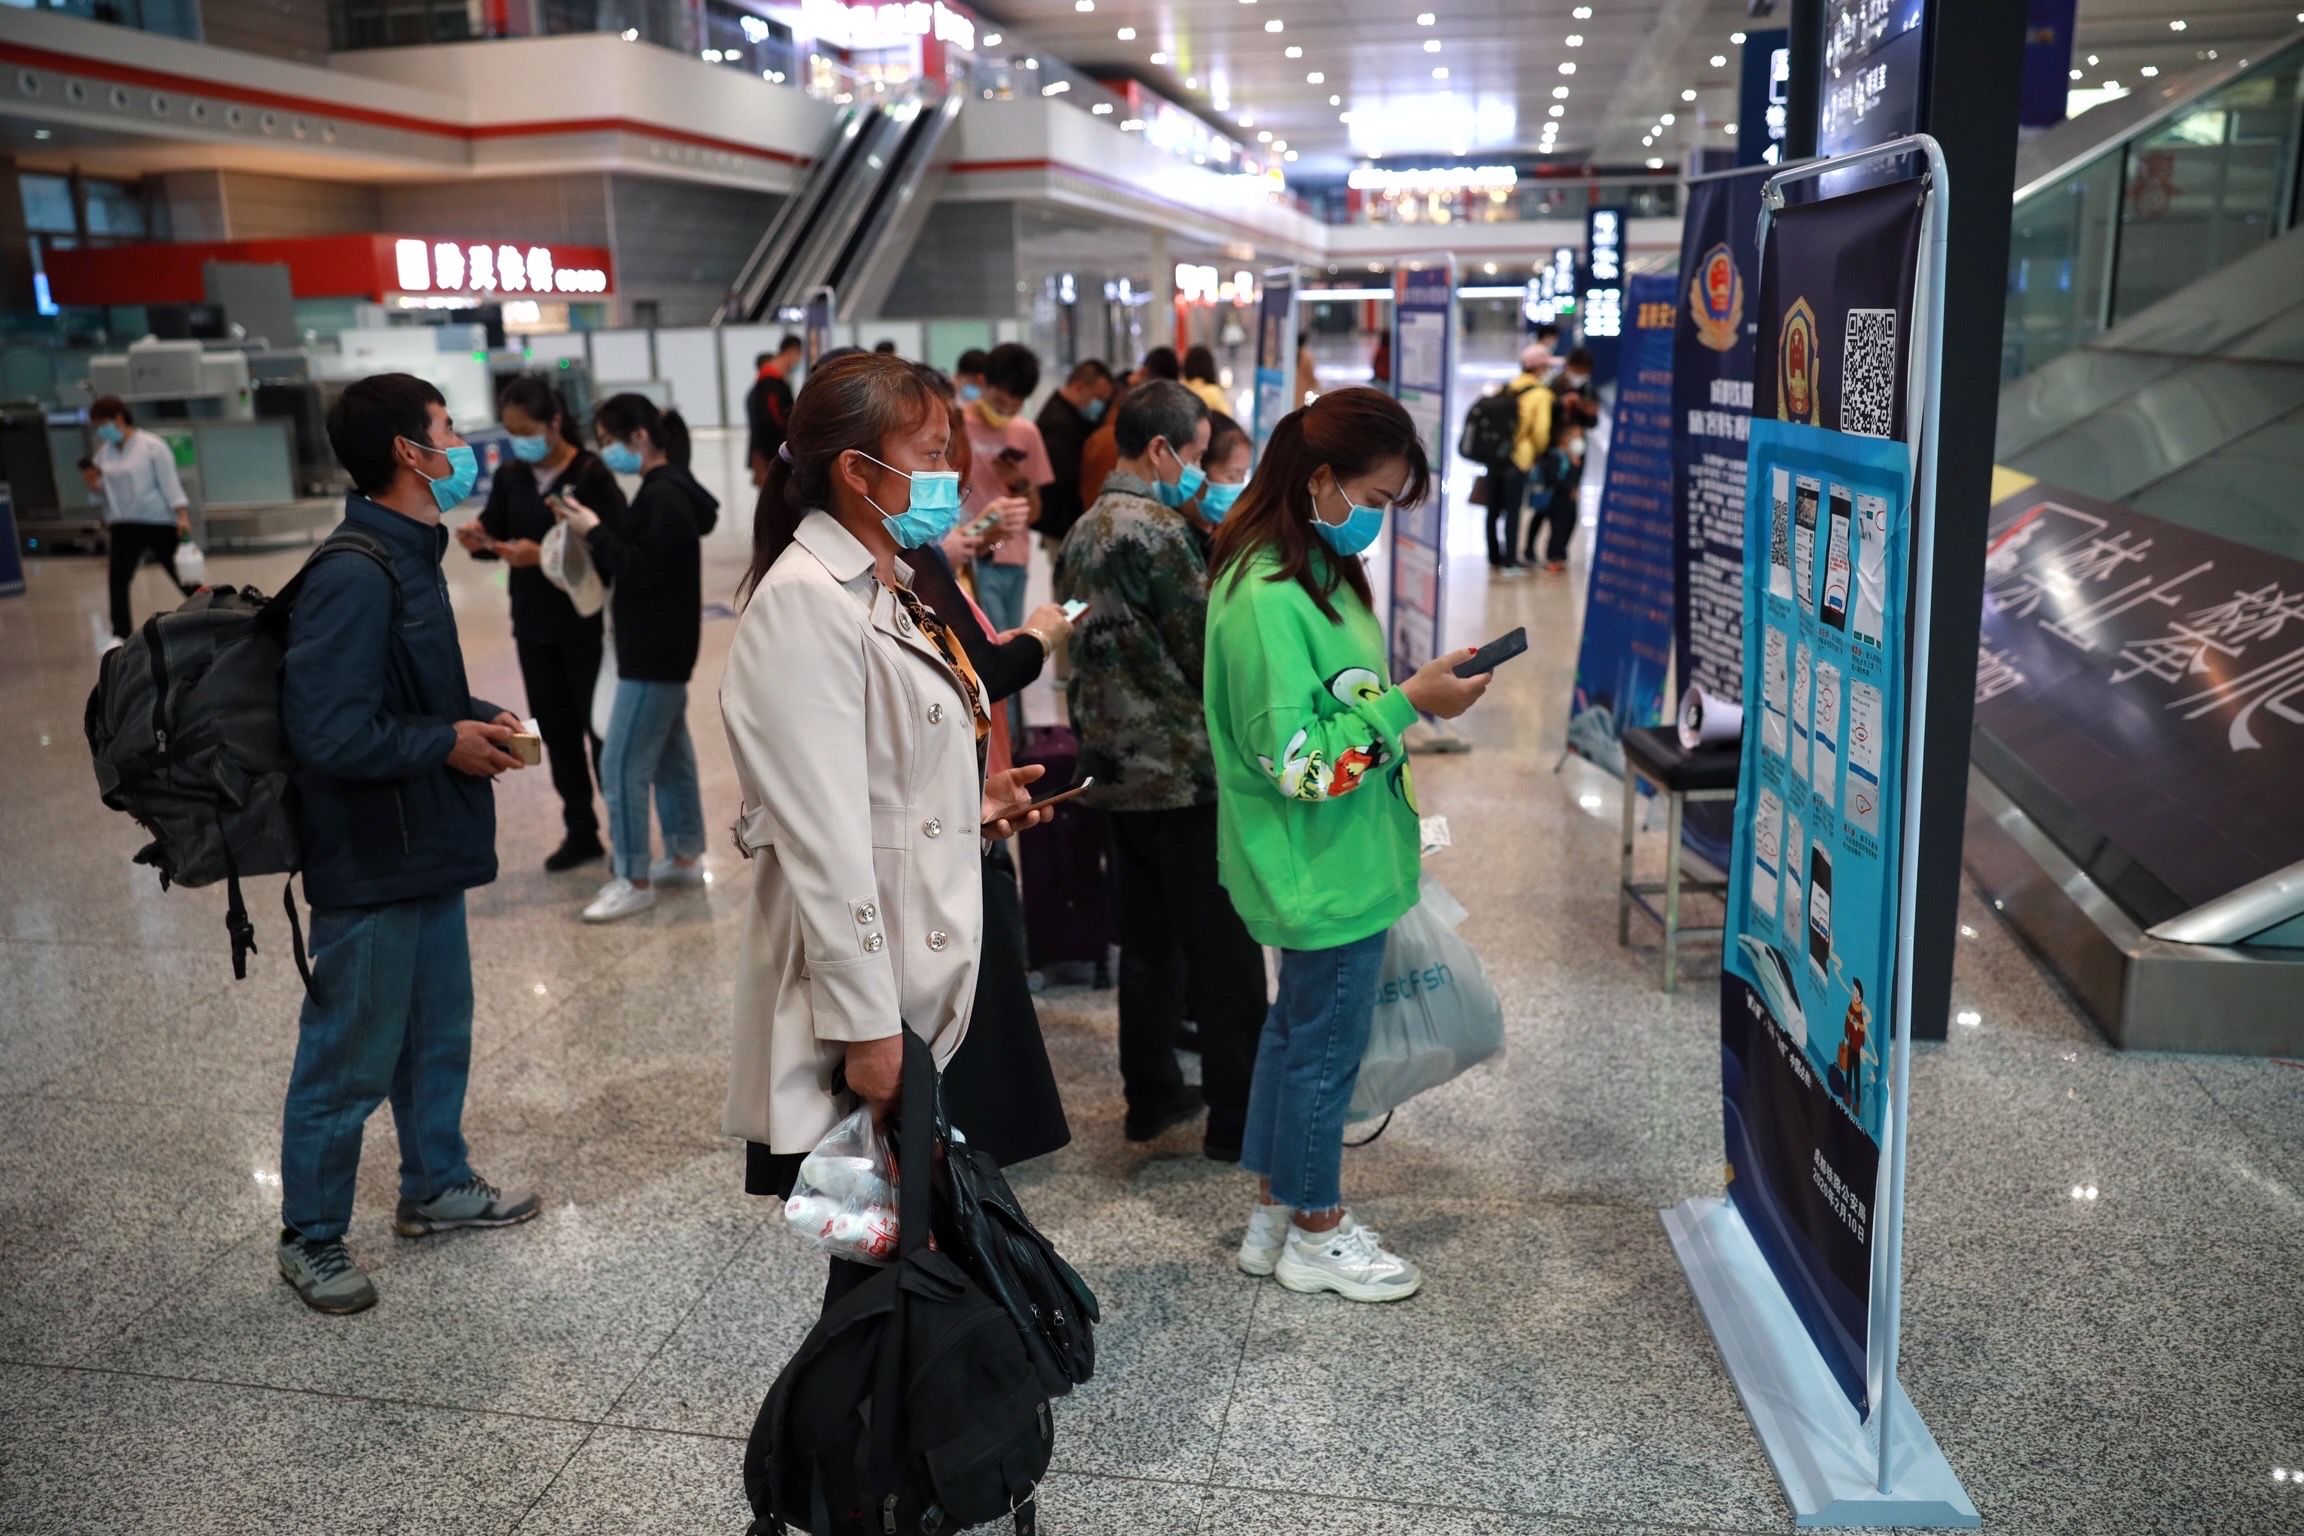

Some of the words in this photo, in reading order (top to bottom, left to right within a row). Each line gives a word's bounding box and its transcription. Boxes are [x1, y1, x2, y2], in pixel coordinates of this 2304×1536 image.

[1812, 1167, 1866, 1245] 2020年2月10日
[1813, 1147, 1867, 1225] 成都铁路公安局
